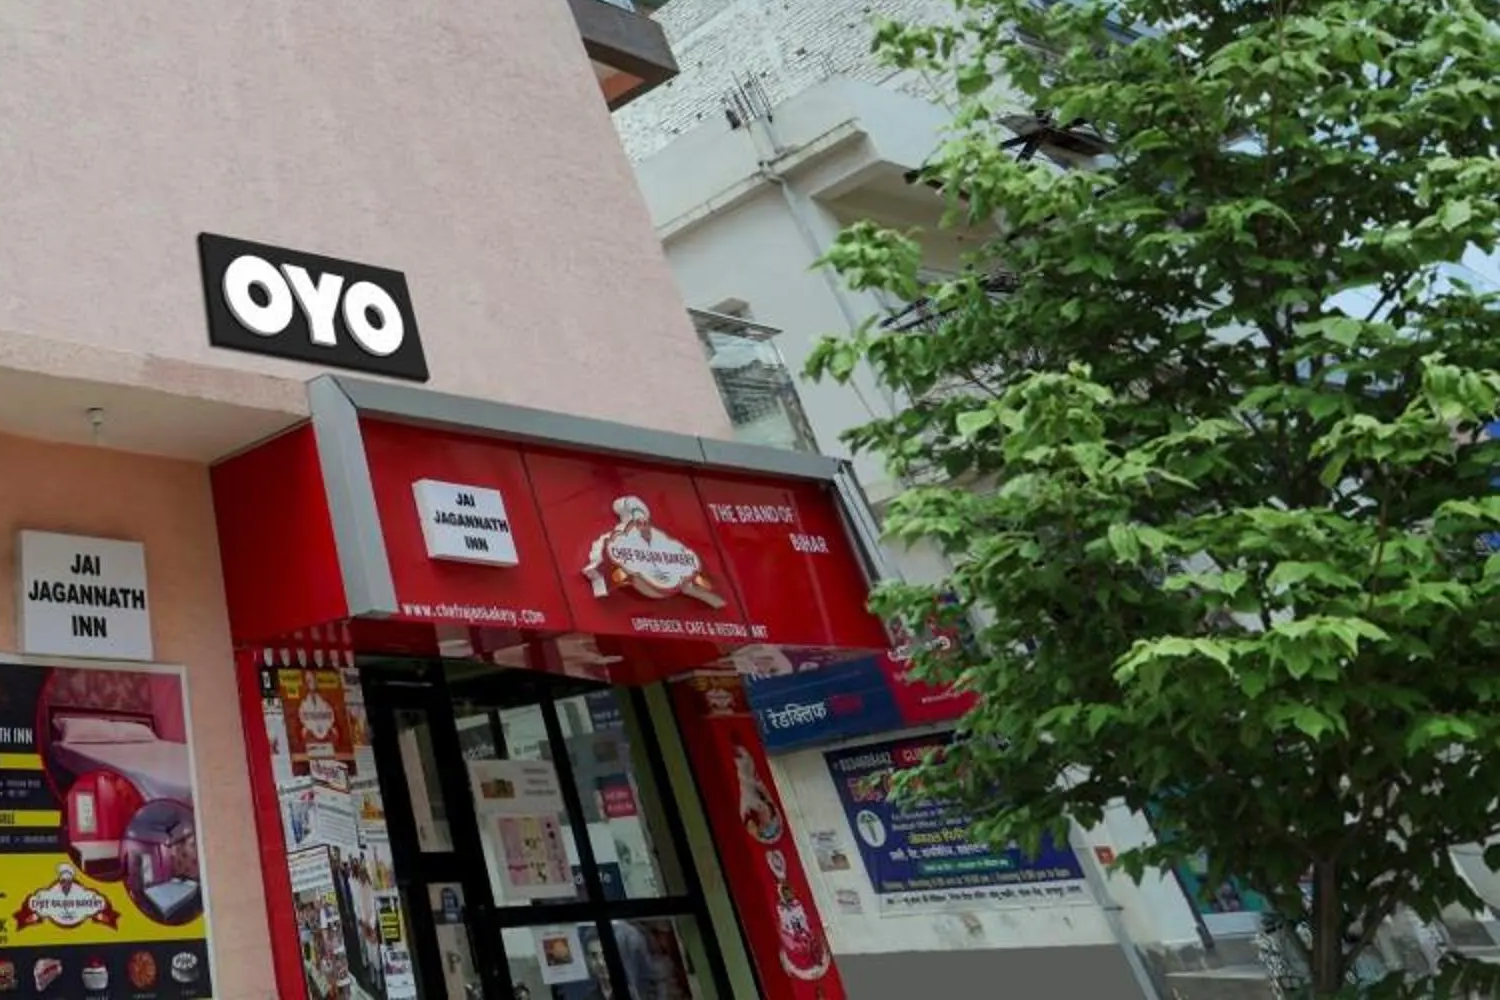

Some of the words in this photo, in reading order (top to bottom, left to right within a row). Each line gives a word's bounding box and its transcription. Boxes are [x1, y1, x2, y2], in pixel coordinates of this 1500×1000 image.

[222, 255, 405, 357] OYO
[456, 492, 477, 507] JAI
[434, 510, 509, 533] JAGANNATH
[708, 503, 738, 523] THE
[735, 504, 779, 523] BRAND
[778, 505, 795, 523] OF
[464, 535, 489, 552] INN
[789, 532, 829, 553] BIHAR
[70, 553, 101, 576] JAI
[28, 580, 145, 610] JAGANNATH
[71, 615, 108, 638] INN
[13, 727, 33, 744] INN
